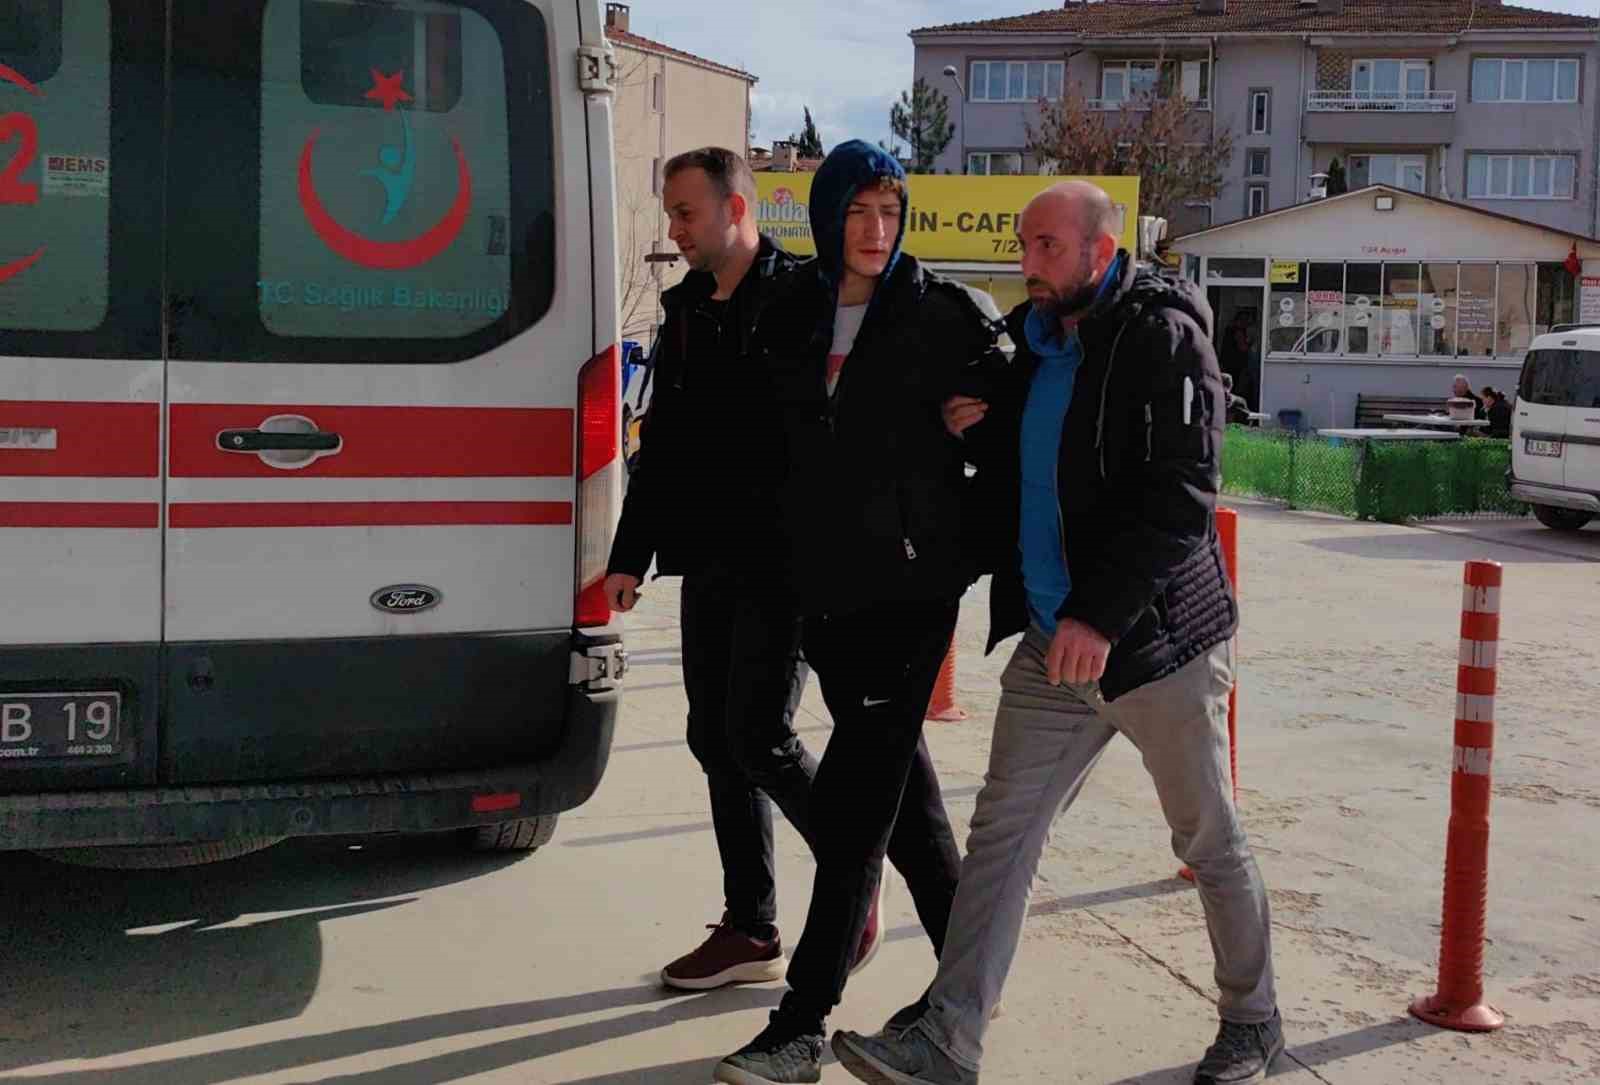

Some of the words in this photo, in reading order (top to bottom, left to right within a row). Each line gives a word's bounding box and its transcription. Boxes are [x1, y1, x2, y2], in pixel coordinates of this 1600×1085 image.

[65, 157, 105, 173] EMS
[386, 591, 426, 606] Ford
[63, 701, 111, 740] 19
